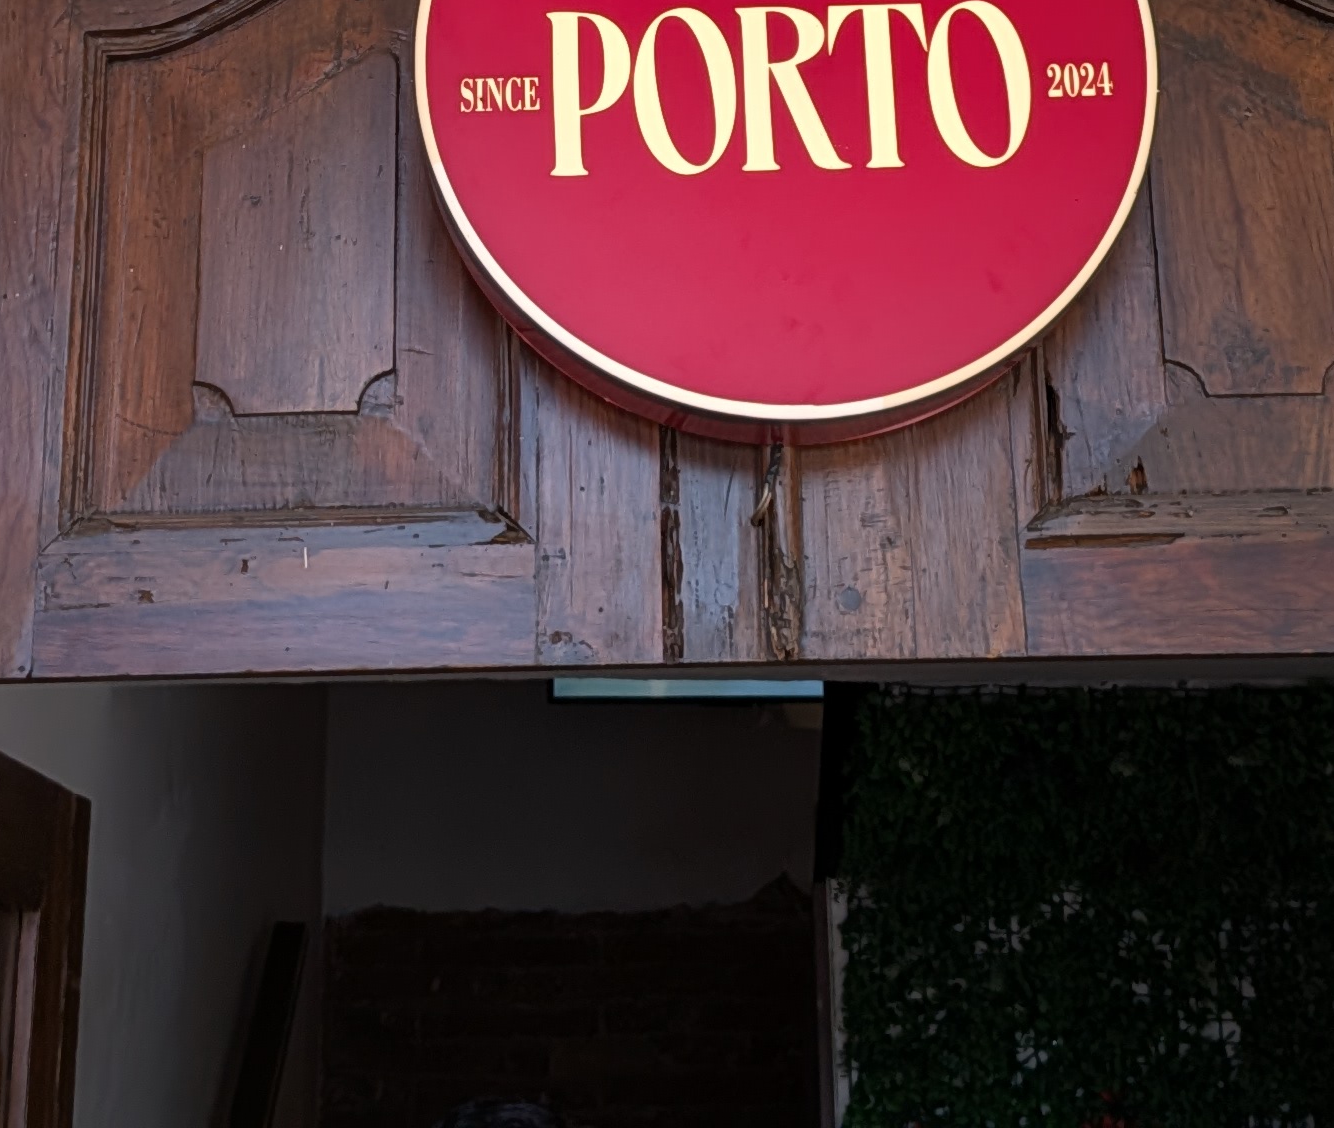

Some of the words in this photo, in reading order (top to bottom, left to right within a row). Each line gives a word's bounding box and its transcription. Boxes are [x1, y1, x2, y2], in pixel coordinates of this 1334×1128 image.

[460, 76, 541, 113] SINCE
[545, 0, 1032, 177] PORTO
[1046, 62, 1114, 98] 2024
